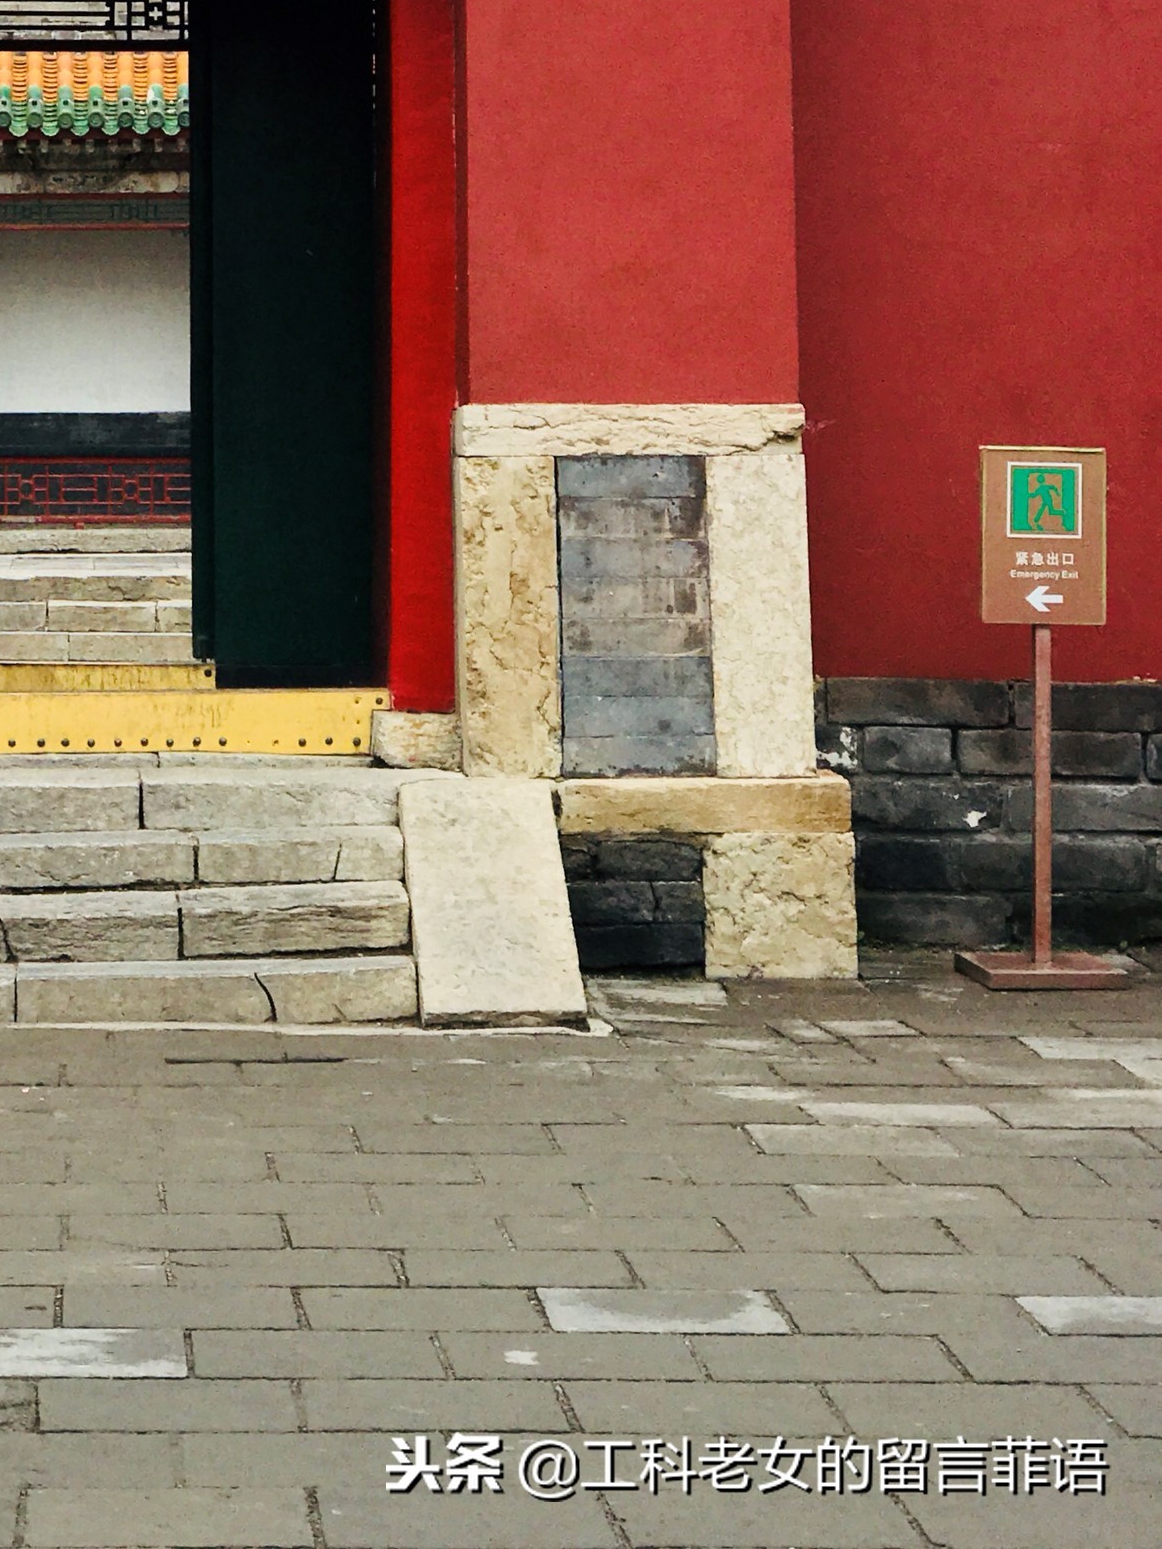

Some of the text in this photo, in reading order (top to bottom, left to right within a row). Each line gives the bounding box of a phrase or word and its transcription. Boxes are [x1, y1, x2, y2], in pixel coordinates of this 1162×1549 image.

[1015, 552, 1074, 566] 紧急出口
[1010, 570, 1079, 580] Emergency Exit
